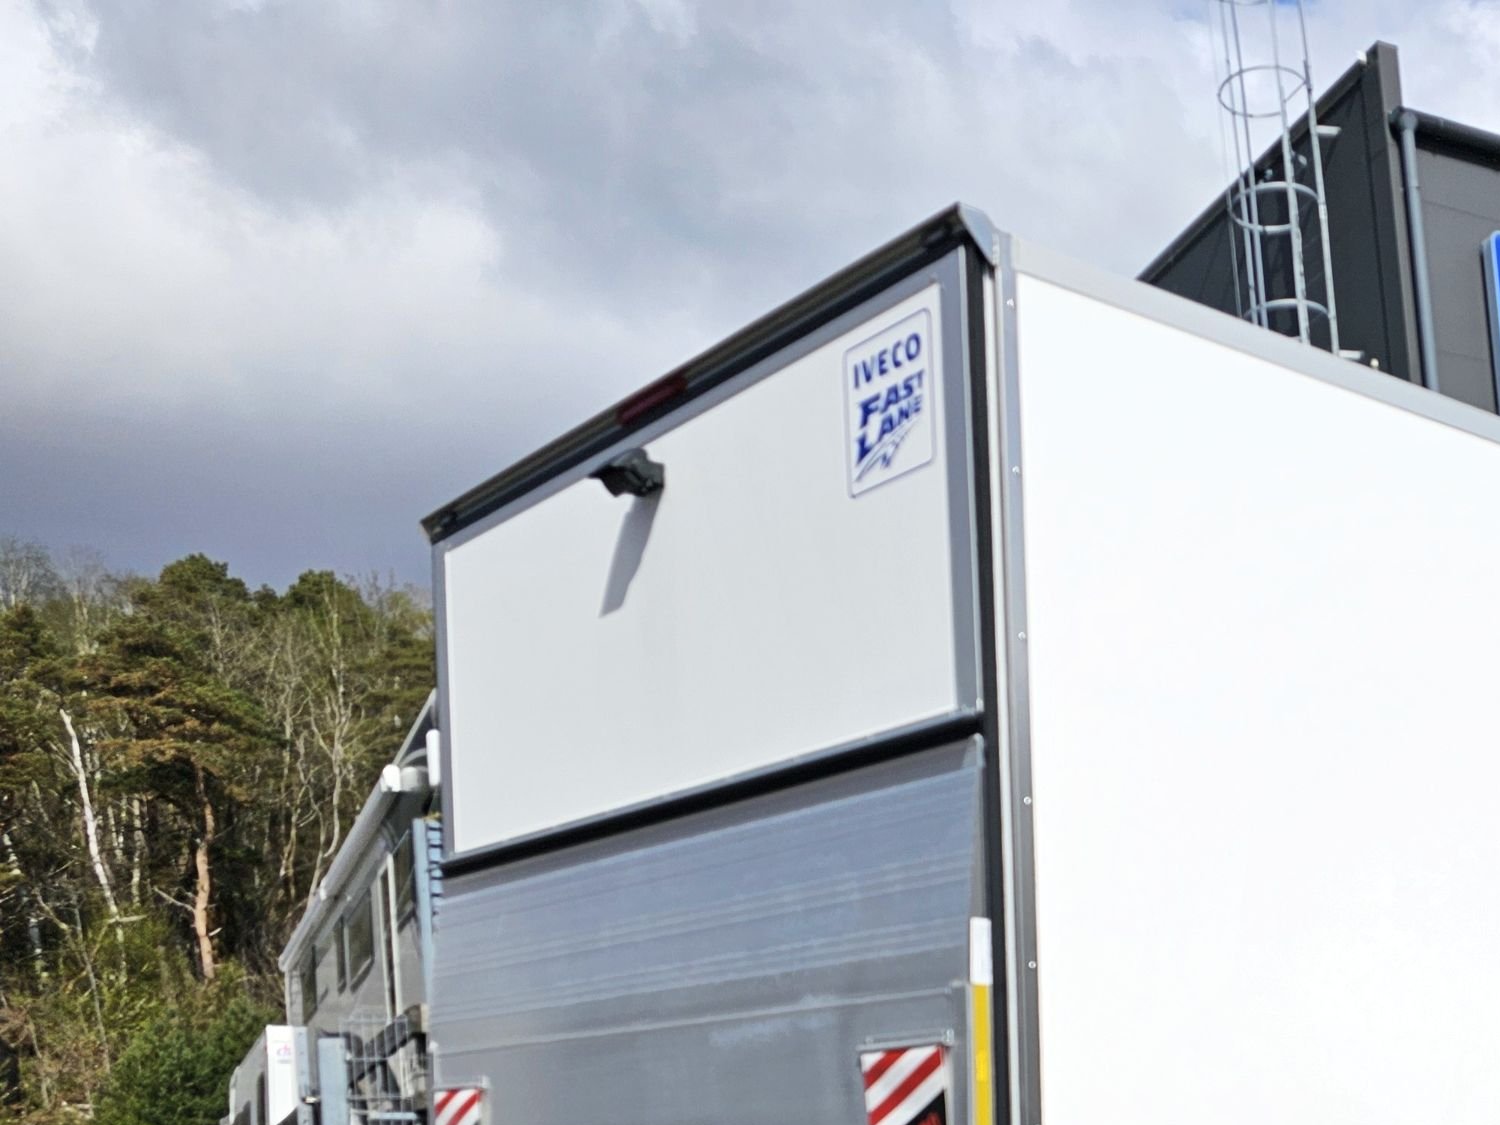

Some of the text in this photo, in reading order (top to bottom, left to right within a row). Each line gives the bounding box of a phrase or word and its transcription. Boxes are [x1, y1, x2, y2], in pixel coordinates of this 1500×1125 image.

[853, 333, 921, 389] IVECO
[858, 369, 925, 430] FAST
[856, 394, 922, 467] LANE
